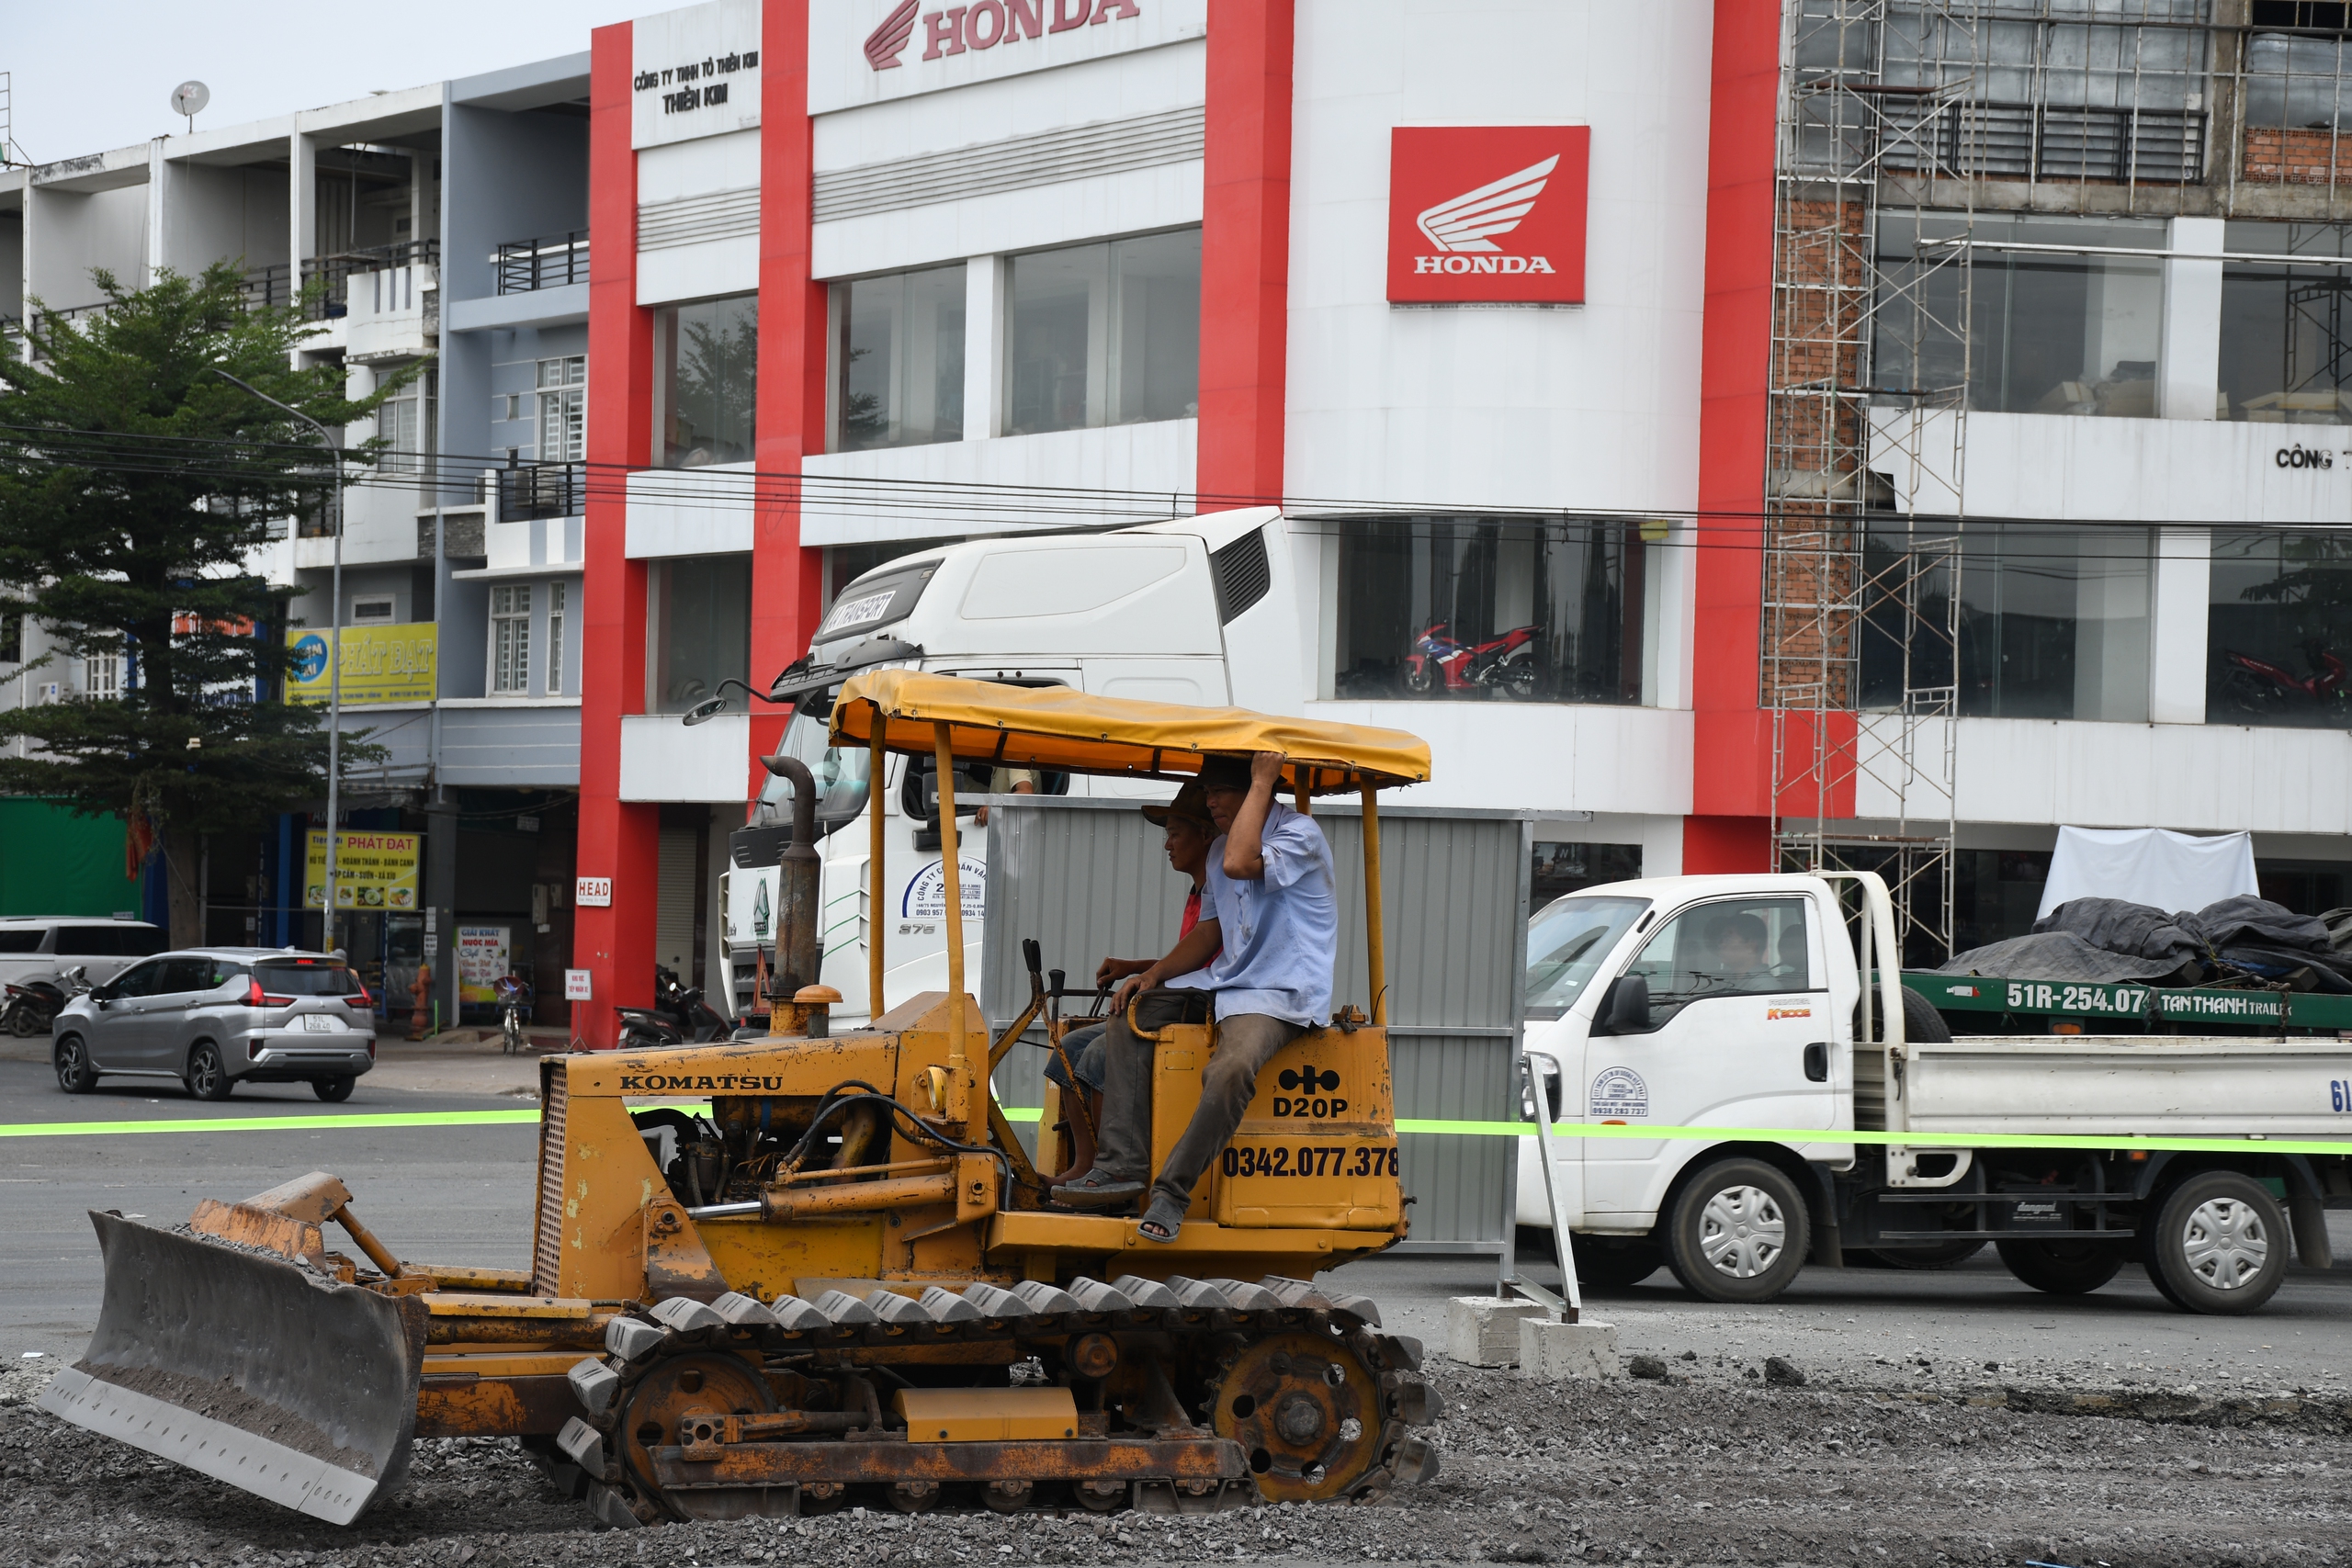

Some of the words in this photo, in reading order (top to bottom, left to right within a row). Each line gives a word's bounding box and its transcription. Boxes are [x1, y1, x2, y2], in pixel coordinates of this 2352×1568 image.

[661, 69, 673, 86] TY
[675, 63, 699, 84] TNHH
[742, 51, 758, 70] KIM
[704, 83, 728, 107] KIM
[1414, 255, 1555, 275] HONDA
[2276, 443, 2333, 469] CÔNG
[837, 592, 894, 626] TRANSPORT
[339, 633, 387, 676] PHÁT
[390, 638, 434, 682] ĐẠT
[347, 834, 384, 850] PHÁT
[387, 838, 413, 853] ĐẠT
[317, 855, 327, 864] TIẾ
[579, 881, 609, 896] HEAD
[917, 881, 930, 901] CÔNG
[926, 872, 936, 881] TY
[899, 923, 935, 935] 375
[2007, 983, 2145, 1013] 51R-254.07
[620, 1075, 783, 1090] KOMATSU
[1273, 1097, 1348, 1118] D20P
[1223, 1147, 1398, 1178] 0342.077.378
